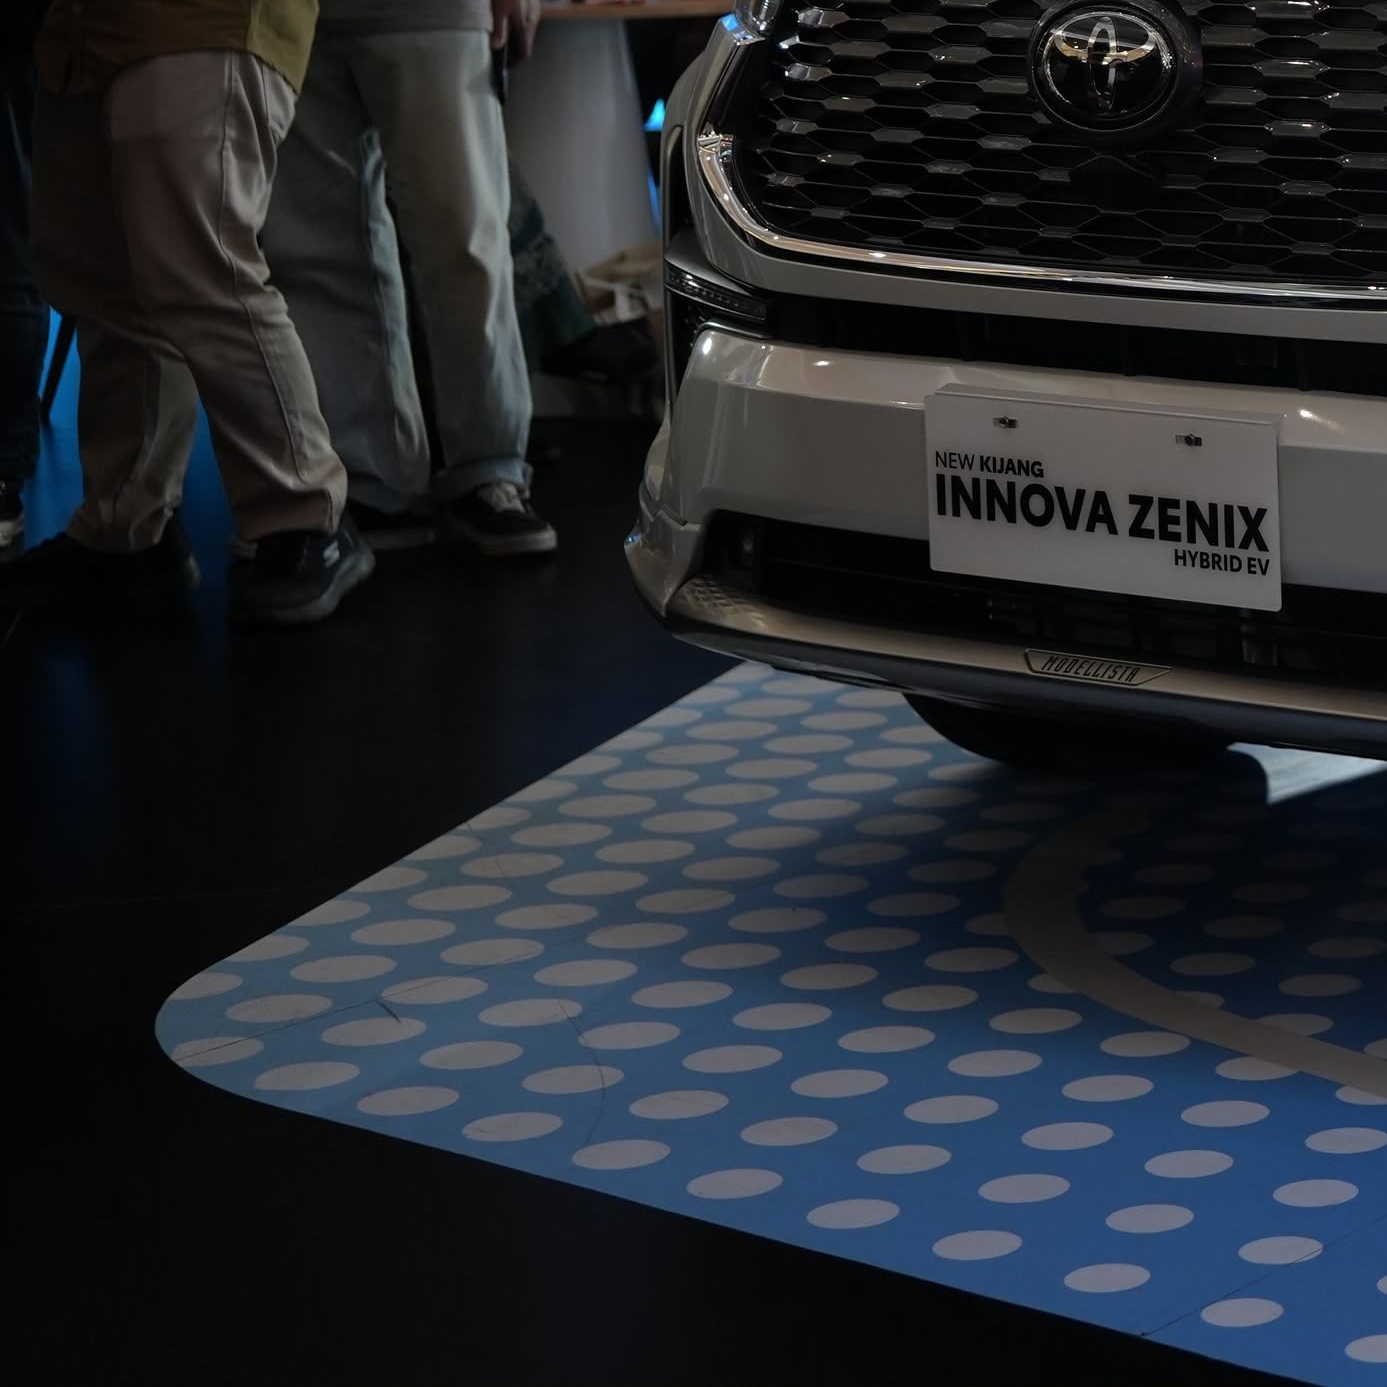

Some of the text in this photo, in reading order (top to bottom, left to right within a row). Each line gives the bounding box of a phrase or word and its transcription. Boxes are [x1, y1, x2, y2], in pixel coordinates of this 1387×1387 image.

[935, 451, 1045, 479] NEW KIJANG
[936, 473, 1270, 553] INNOVA ZENIX
[1174, 549, 1270, 576] HYBRID EV
[1041, 655, 1140, 683] MODELLISTA
